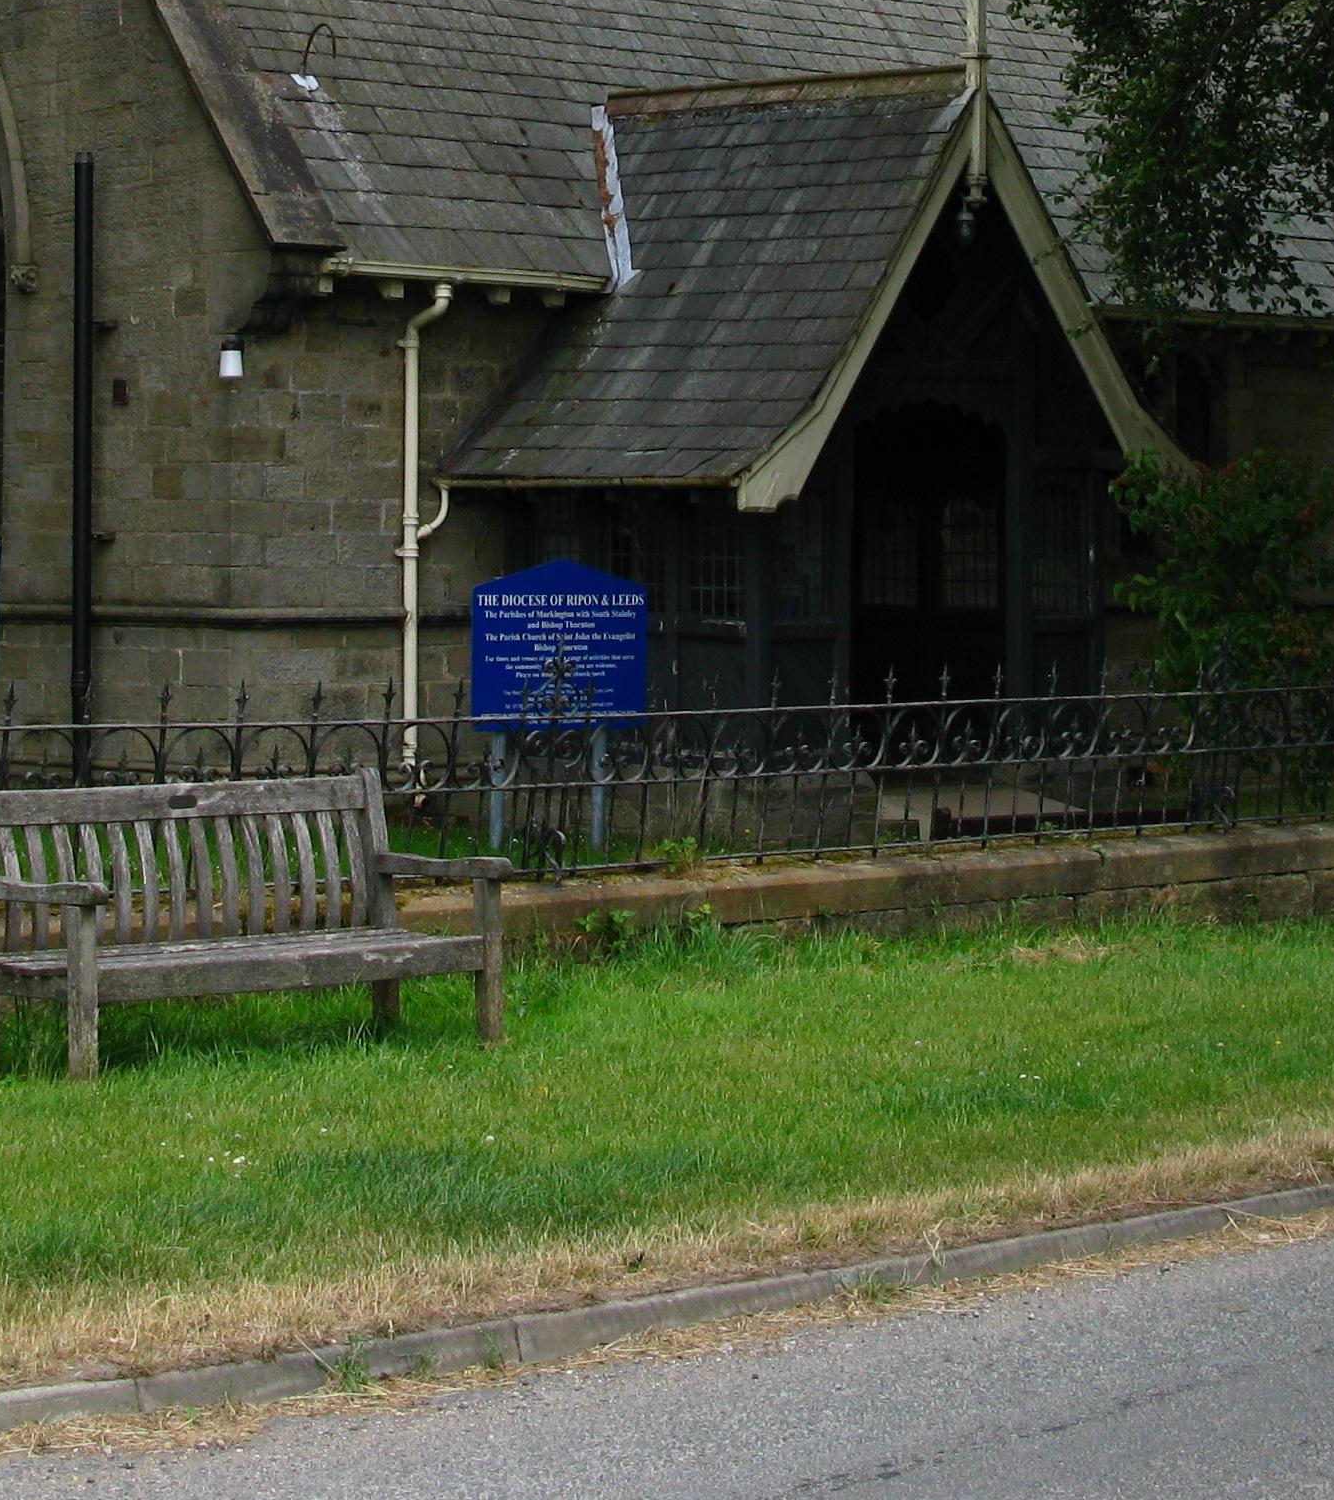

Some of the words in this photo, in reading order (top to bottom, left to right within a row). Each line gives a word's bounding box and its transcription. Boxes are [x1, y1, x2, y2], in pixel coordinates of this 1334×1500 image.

[478, 594, 499, 607] THE
[502, 594, 548, 607] DIOCESE
[550, 594, 565, 607] OF
[567, 594, 599, 607] RIPON
[601, 594, 610, 606] &
[612, 594, 645, 606] LEEDS
[485, 610, 498, 619] The
[499, 610, 527, 619] Parishes
[528, 610, 535, 618] of
[536, 610, 574, 620] Markington
[576, 610, 590, 618] with
[591, 609, 610, 618] South
[611, 609, 636, 619] Stainley
[527, 621, 540, 629] and
[542, 621, 564, 631] Bishop
[565, 620, 596, 629] Thornton
[485, 633, 498, 641] The
[499, 633, 521, 641] Parish
[521, 633, 547, 641] Church
[548, 632, 555, 641] of
[574, 632, 590, 640] John
[591, 632, 602, 640] the
[603, 632, 636, 642] Evangelist
[534, 644, 556, 653] Bishop
